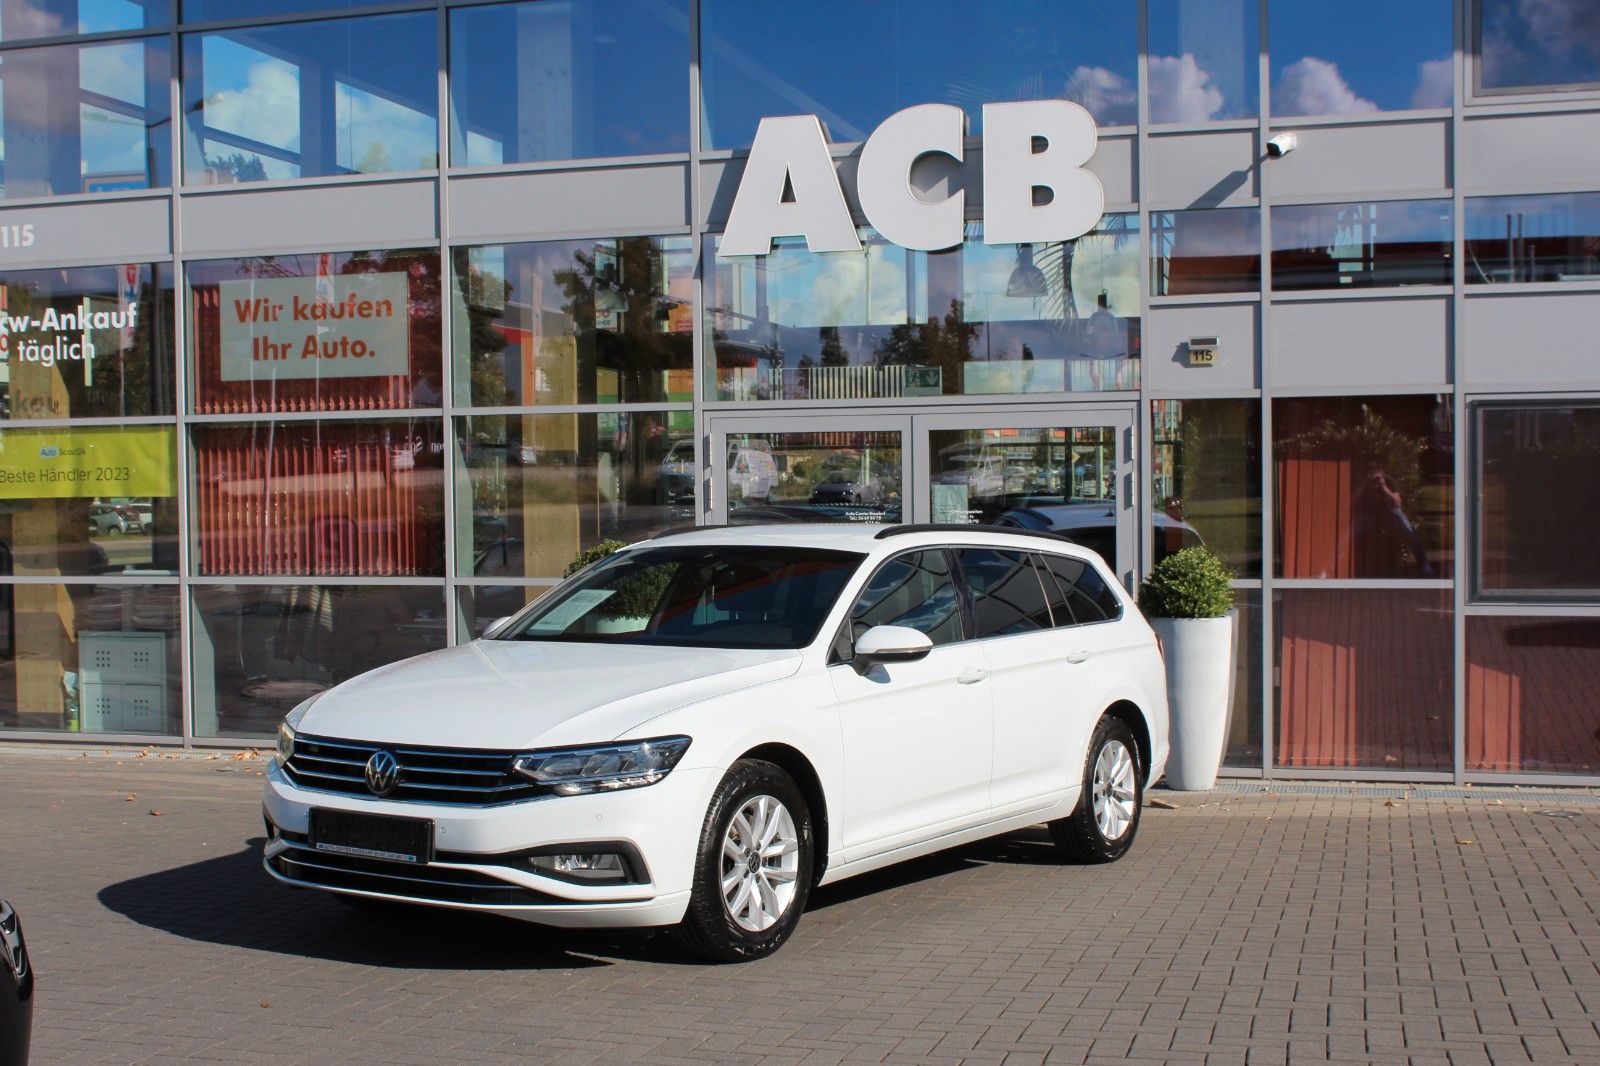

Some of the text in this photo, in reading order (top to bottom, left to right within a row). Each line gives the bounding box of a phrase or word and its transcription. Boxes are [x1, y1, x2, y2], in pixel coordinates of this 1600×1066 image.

[718, 99, 1105, 257] ACB
[0, 224, 35, 248] 115
[234, 292, 393, 323] Wir kaufen
[17, 334, 95, 367] täglich
[252, 335, 377, 361] Ihr Auto.
[1193, 350, 1213, 362] 115
[0, 466, 130, 484] Beste Händler 2023
